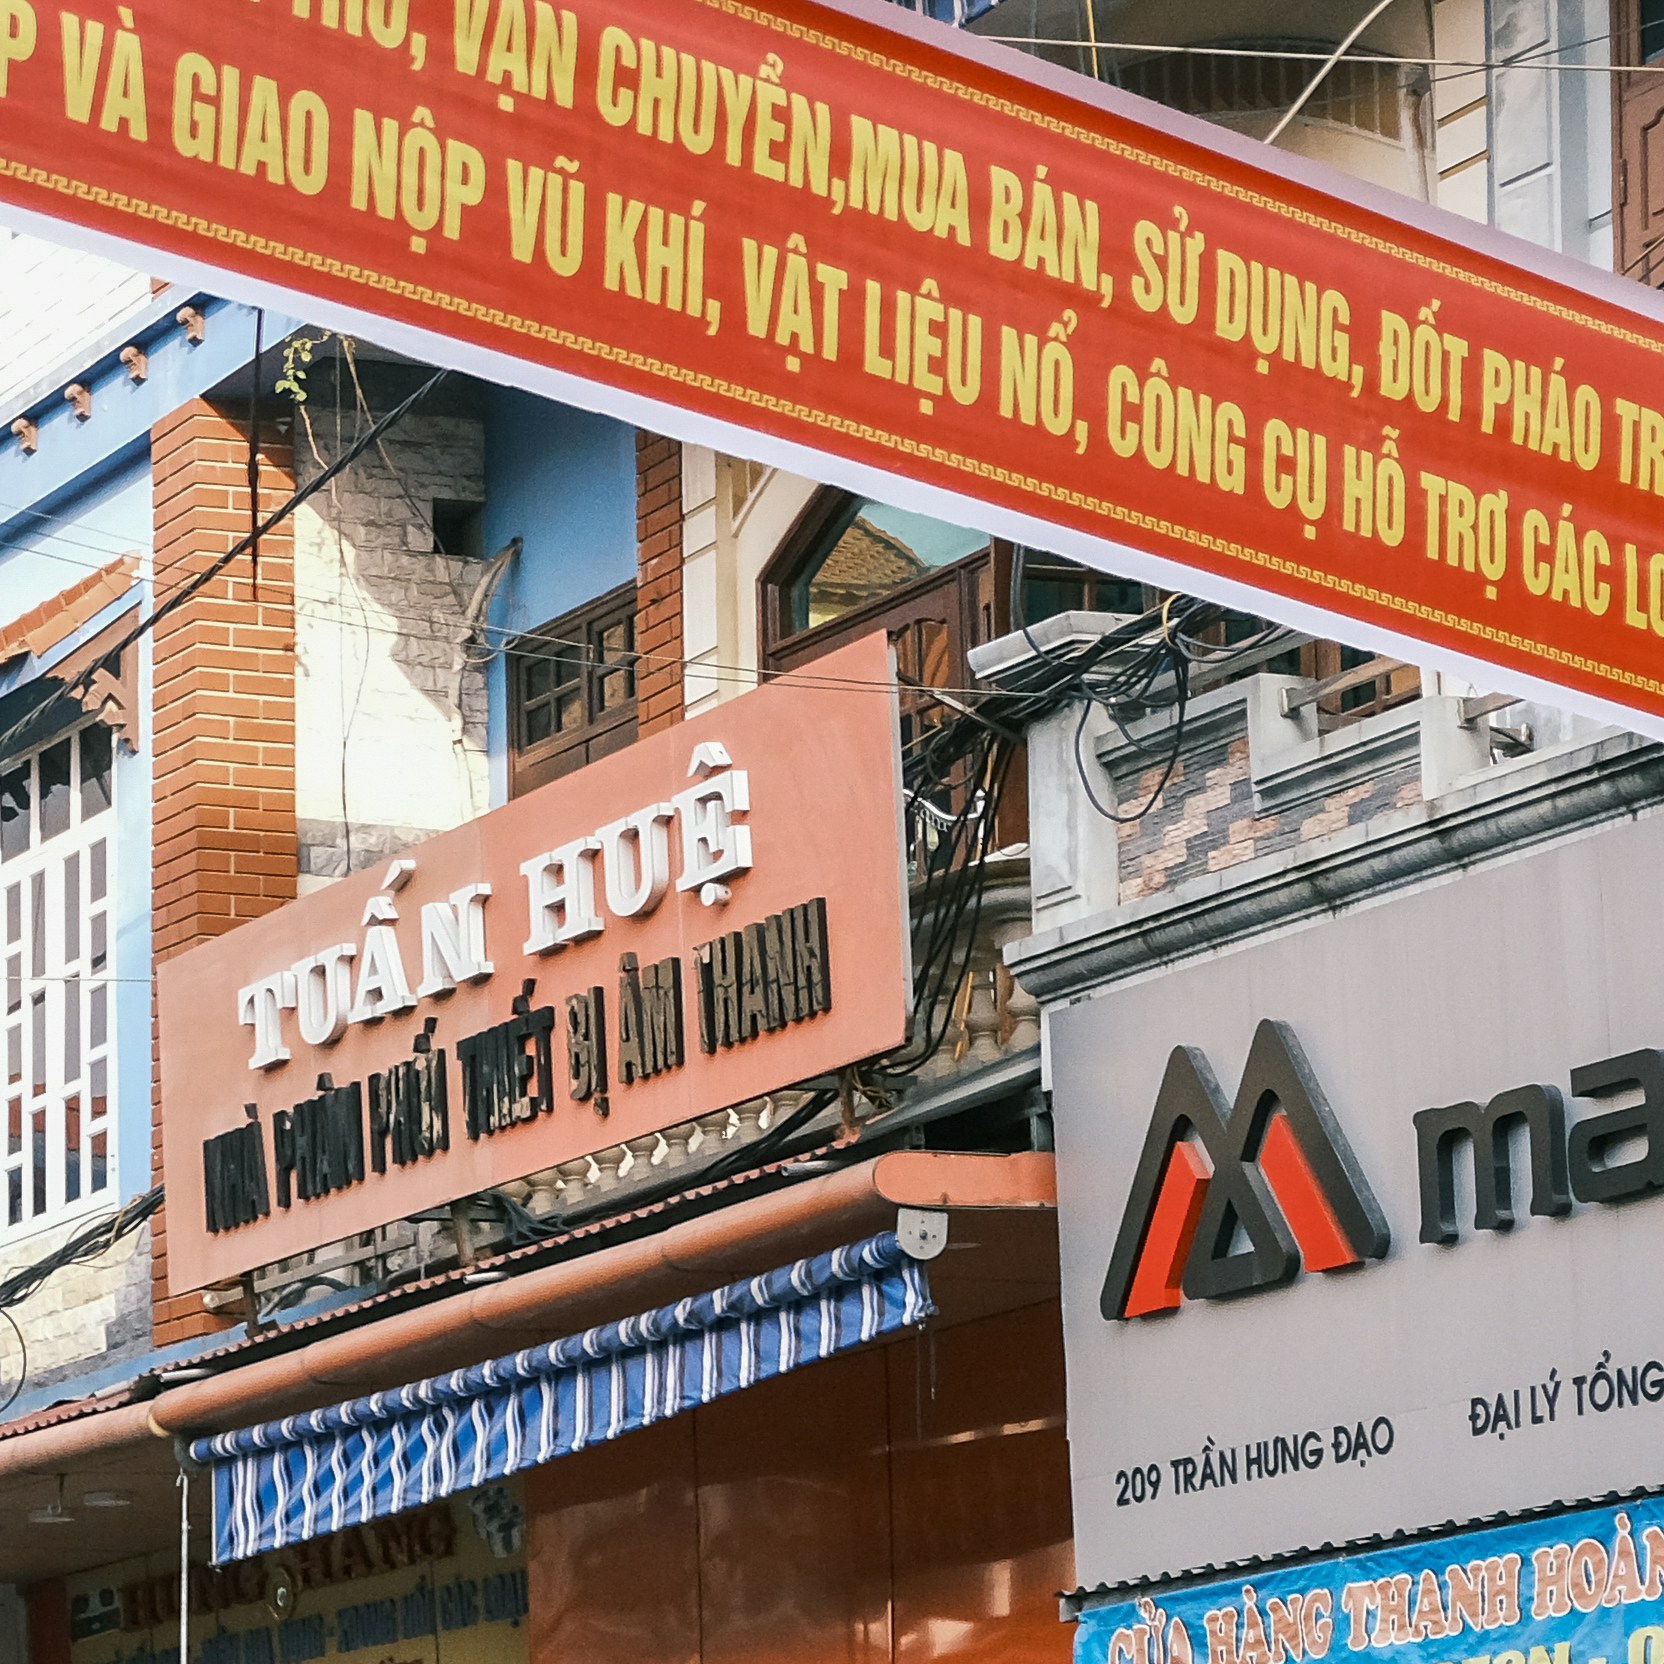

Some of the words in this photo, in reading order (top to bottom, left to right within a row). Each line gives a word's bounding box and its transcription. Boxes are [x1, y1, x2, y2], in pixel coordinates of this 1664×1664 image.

[59, 4, 149, 142] VÀ
[172, 52, 330, 196] GIAO
[350, 106, 486, 255] NỘP
[505, 156, 584, 278] VŨ
[602, 190, 722, 336] KHÍ,
[742, 232, 850, 373] VẬT
[863, 262, 982, 415] LIỆU
[999, 308, 1090, 457] NỔ,
[1107, 356, 1247, 496] CÔNG
[1262, 417, 1328, 540] CỤ
[1342, 425, 1406, 547] HỖ
[1420, 470, 1509, 601] TRỢ
[1521, 502, 1611, 616] CÁC
[989, 164, 1115, 309] BÁN,
[1131, 204, 1206, 326] SỬ
[1215, 247, 1365, 398] DỤNG,
[1379, 298, 1469, 424] ĐỐT
[1480, 347, 1602, 471] PHÁO
[238, 858, 494, 1069] TUẤN
[519, 740, 752, 956] HUỆ
[273, 1071, 365, 1209] PHÂN
[367, 1016, 451, 1175] PHỐI
[456, 977, 556, 1142] THIẾT
[565, 985, 610, 1119] BỊ
[617, 951, 686, 1084] ÂM
[692, 896, 832, 1056] THANH
[1114, 1462, 1161, 1507] 209
[1170, 1435, 1239, 1497] TRẦN
[1245, 1427, 1324, 1482] HƯNG
[1331, 1415, 1396, 1470] ĐẠO
[1468, 1393, 1523, 1445] ĐẠI
[1528, 1367, 1563, 1427] LÝ
[1573, 1350, 1664, 1416] TỔNG
[1345, 1552, 1522, 1651] THANH
